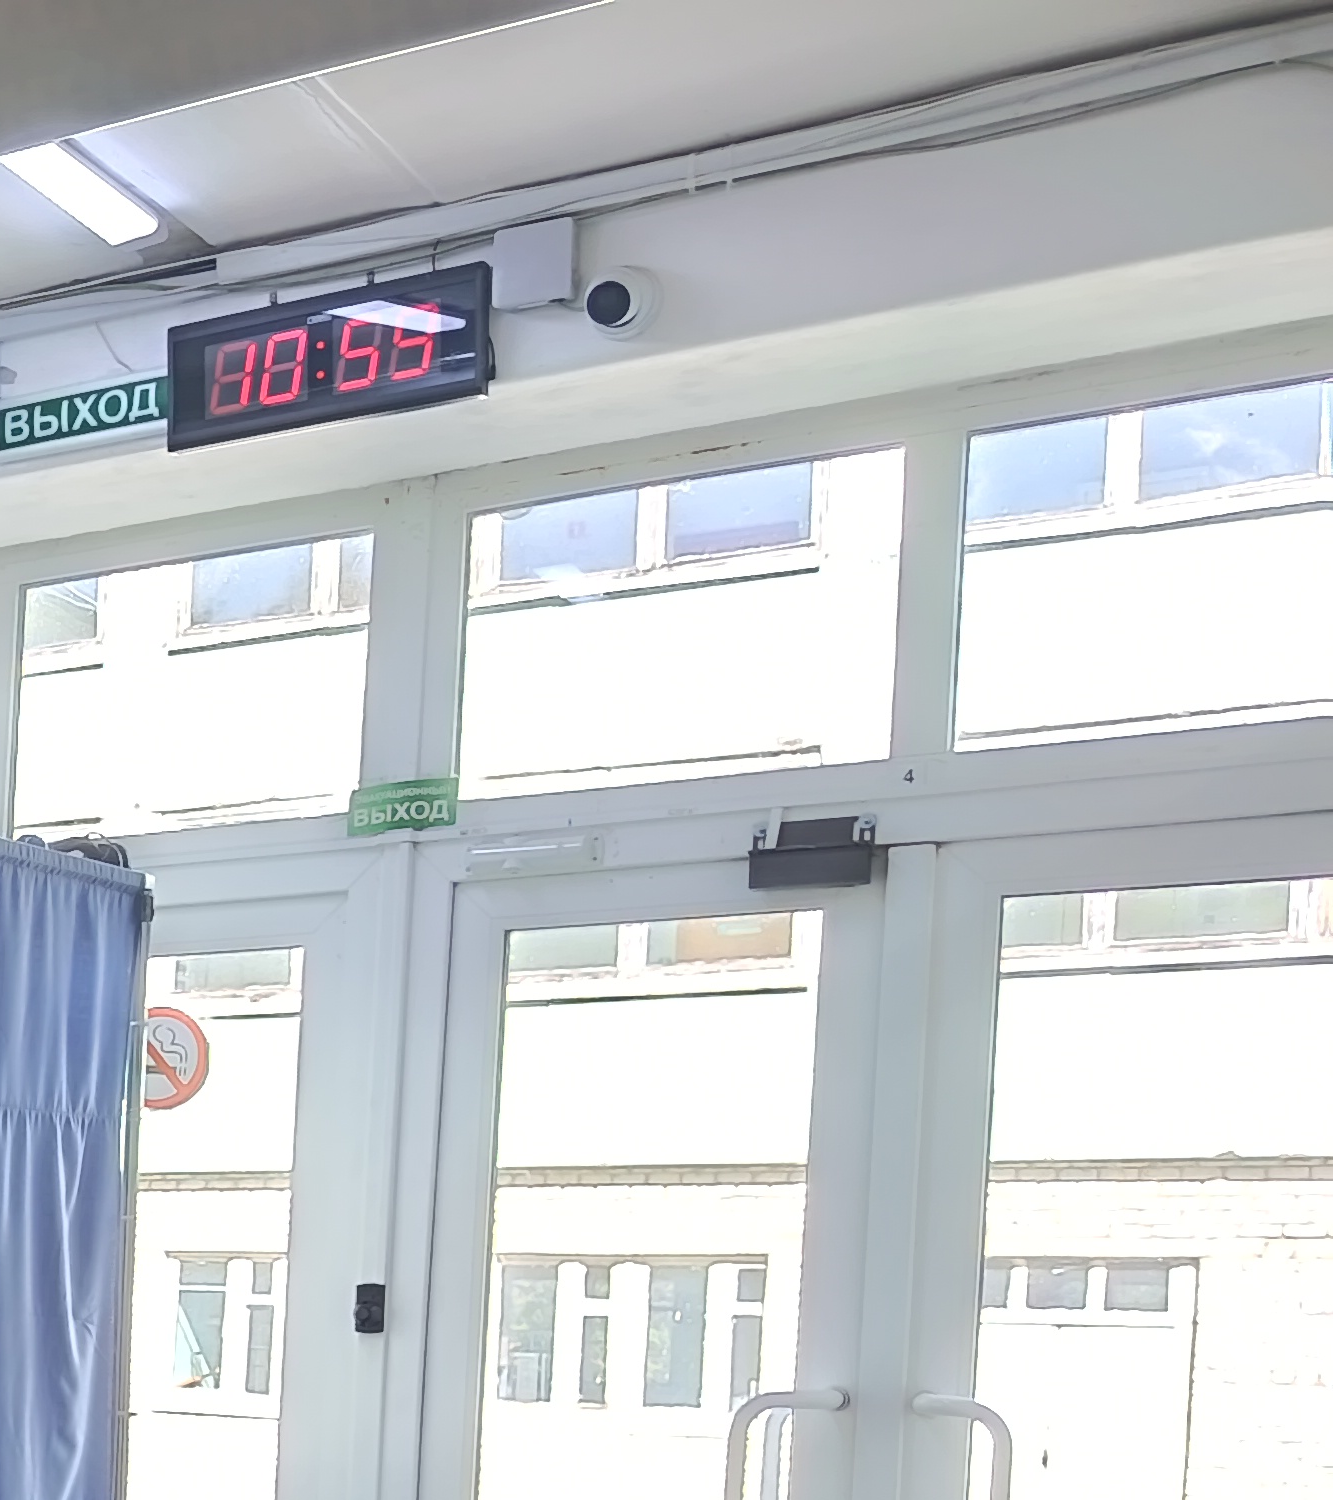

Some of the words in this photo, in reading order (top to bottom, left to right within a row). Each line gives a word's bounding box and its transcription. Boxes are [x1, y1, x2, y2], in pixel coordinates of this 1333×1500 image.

[4, 382, 160, 444] ВЫХОД
[903, 768, 915, 784] 4
[353, 800, 450, 827] ВЫХОД
